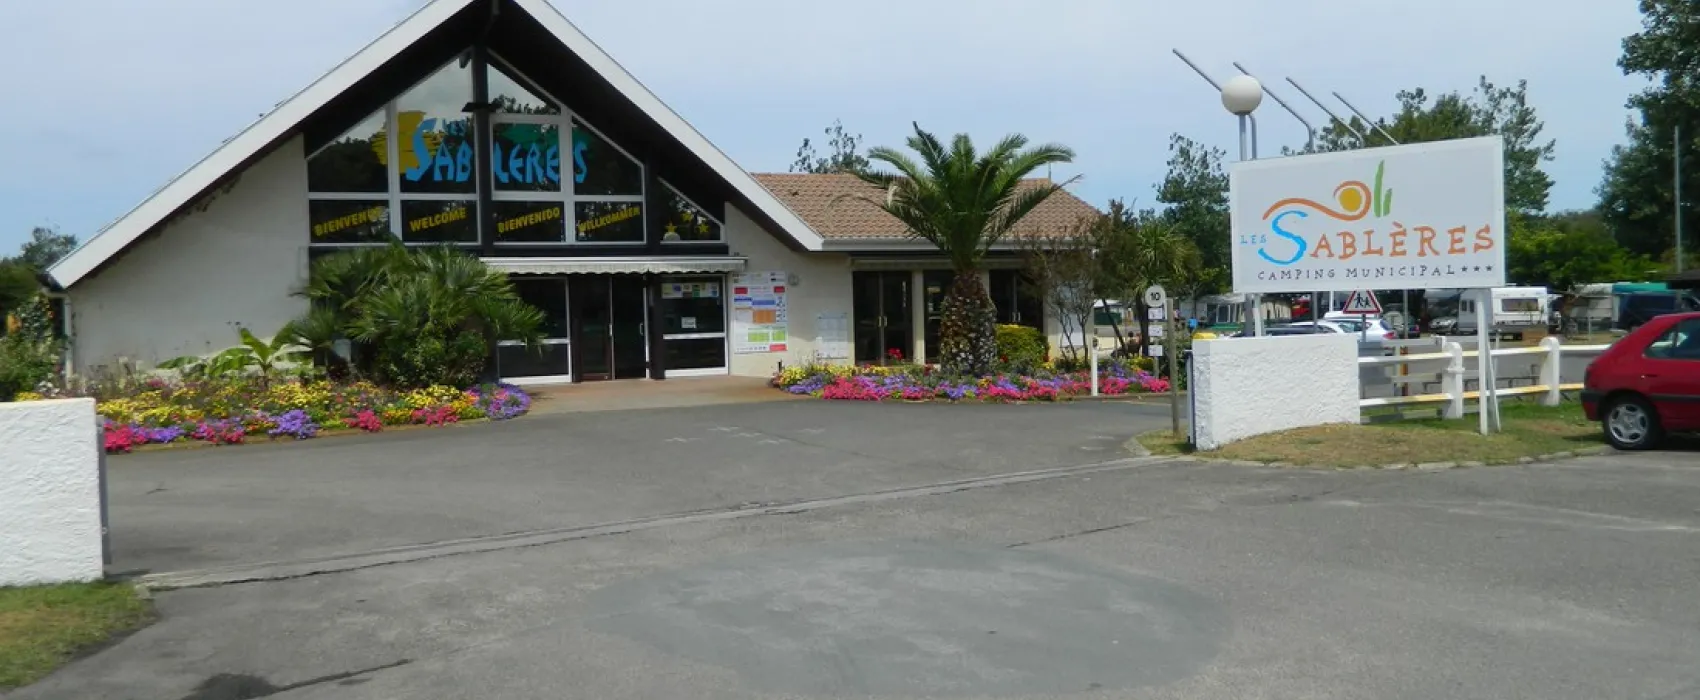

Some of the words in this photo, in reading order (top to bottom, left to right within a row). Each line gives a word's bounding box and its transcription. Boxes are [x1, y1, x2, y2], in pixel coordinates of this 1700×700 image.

[410, 207, 467, 232] WELCOME
[497, 207, 560, 233] BIENVENIDO
[578, 206, 640, 233] WILLKOMMEN
[1240, 234, 1267, 245] LES
[1258, 210, 1494, 266] SABLÈRES
[1257, 268, 1336, 281] CAMPING
[1345, 264, 1455, 278] MUNICIPAL
